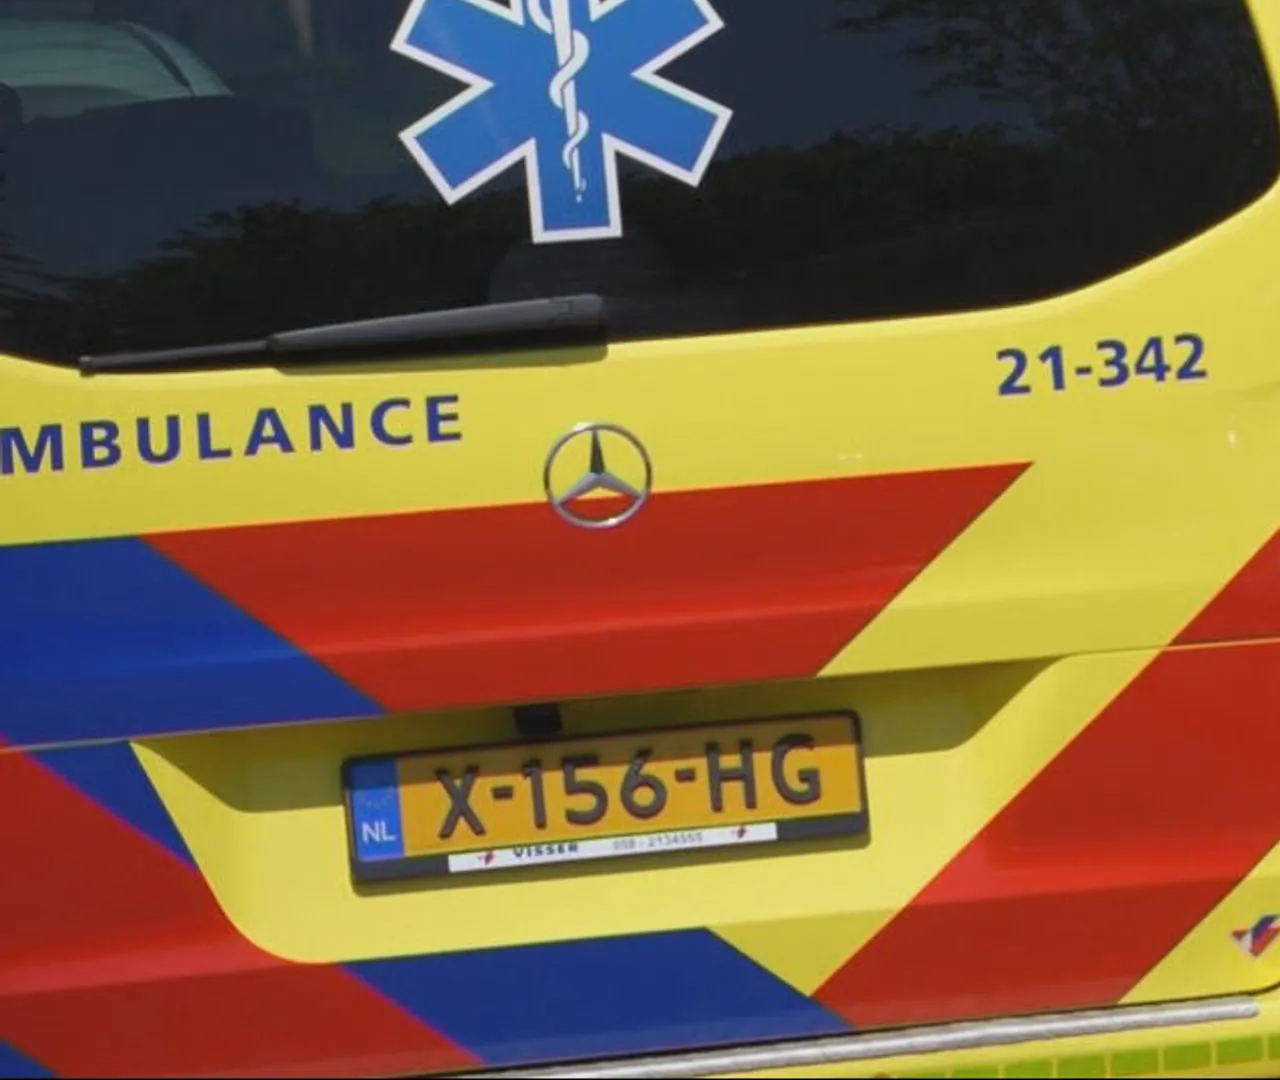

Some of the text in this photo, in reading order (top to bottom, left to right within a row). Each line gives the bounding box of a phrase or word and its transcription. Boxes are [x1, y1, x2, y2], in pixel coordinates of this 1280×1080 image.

[996, 332, 1208, 396] 21-342
[0, 393, 463, 476] MBULANCE
[434, 733, 822, 839] X-156-HG
[361, 821, 396, 843] NL
[513, 842, 579, 858] VISSER
